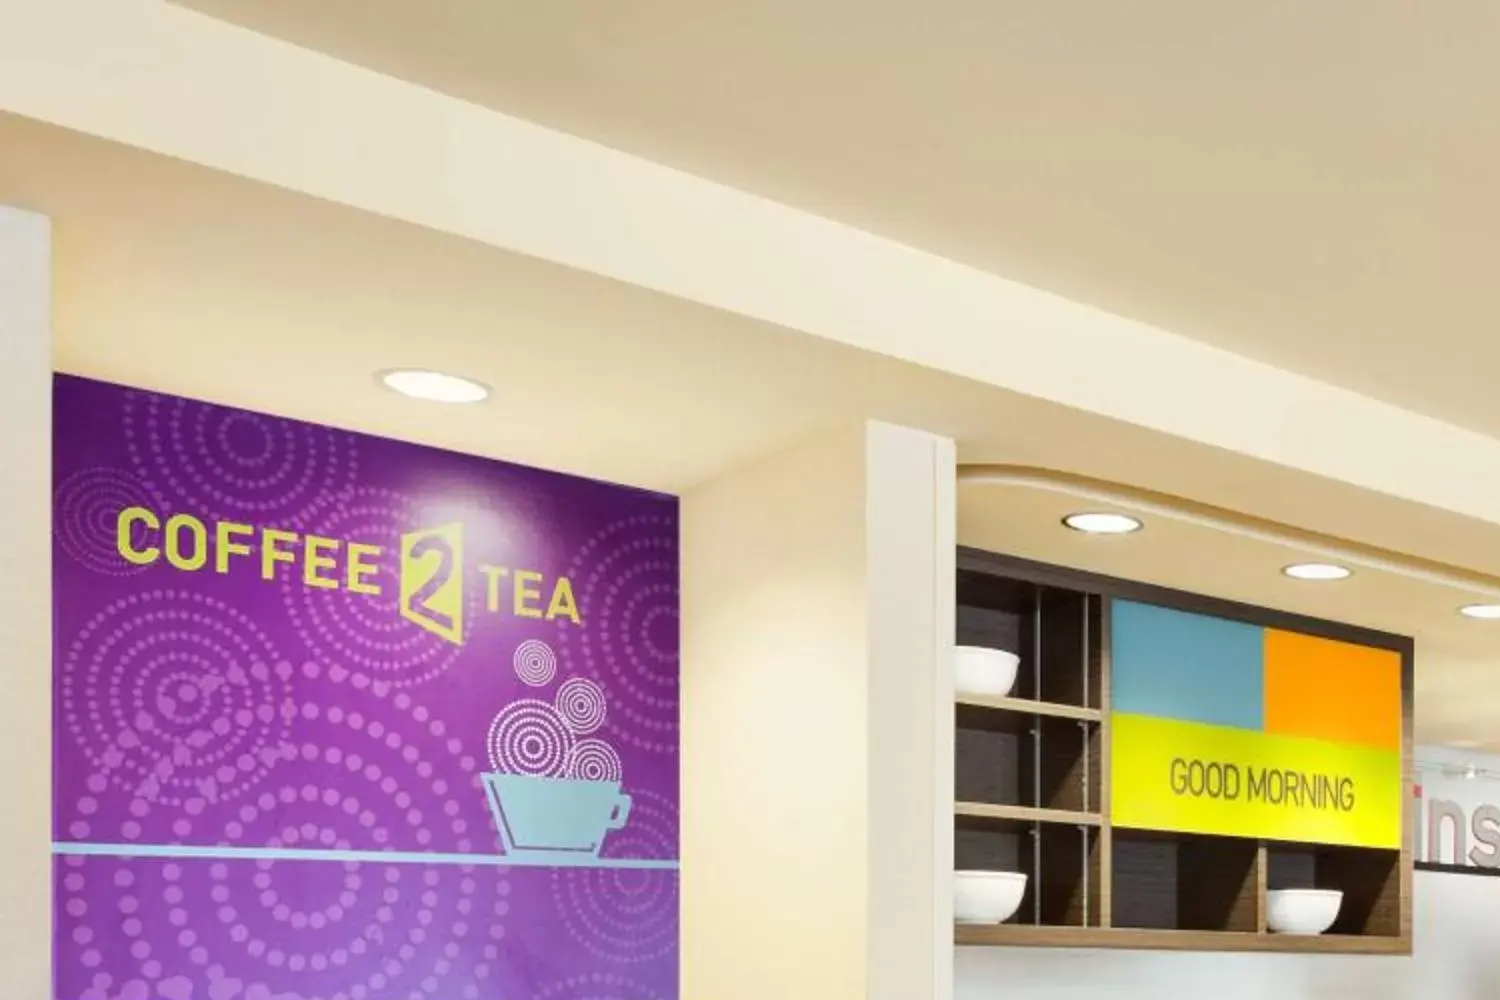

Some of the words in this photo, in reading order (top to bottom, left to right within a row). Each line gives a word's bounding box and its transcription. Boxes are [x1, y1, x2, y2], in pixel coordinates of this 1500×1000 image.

[117, 506, 381, 596] COFFEE
[408, 531, 456, 631] 2
[482, 564, 581, 627] TEA
[1169, 757, 1240, 800] GOOD
[1247, 764, 1356, 812] MORNING
